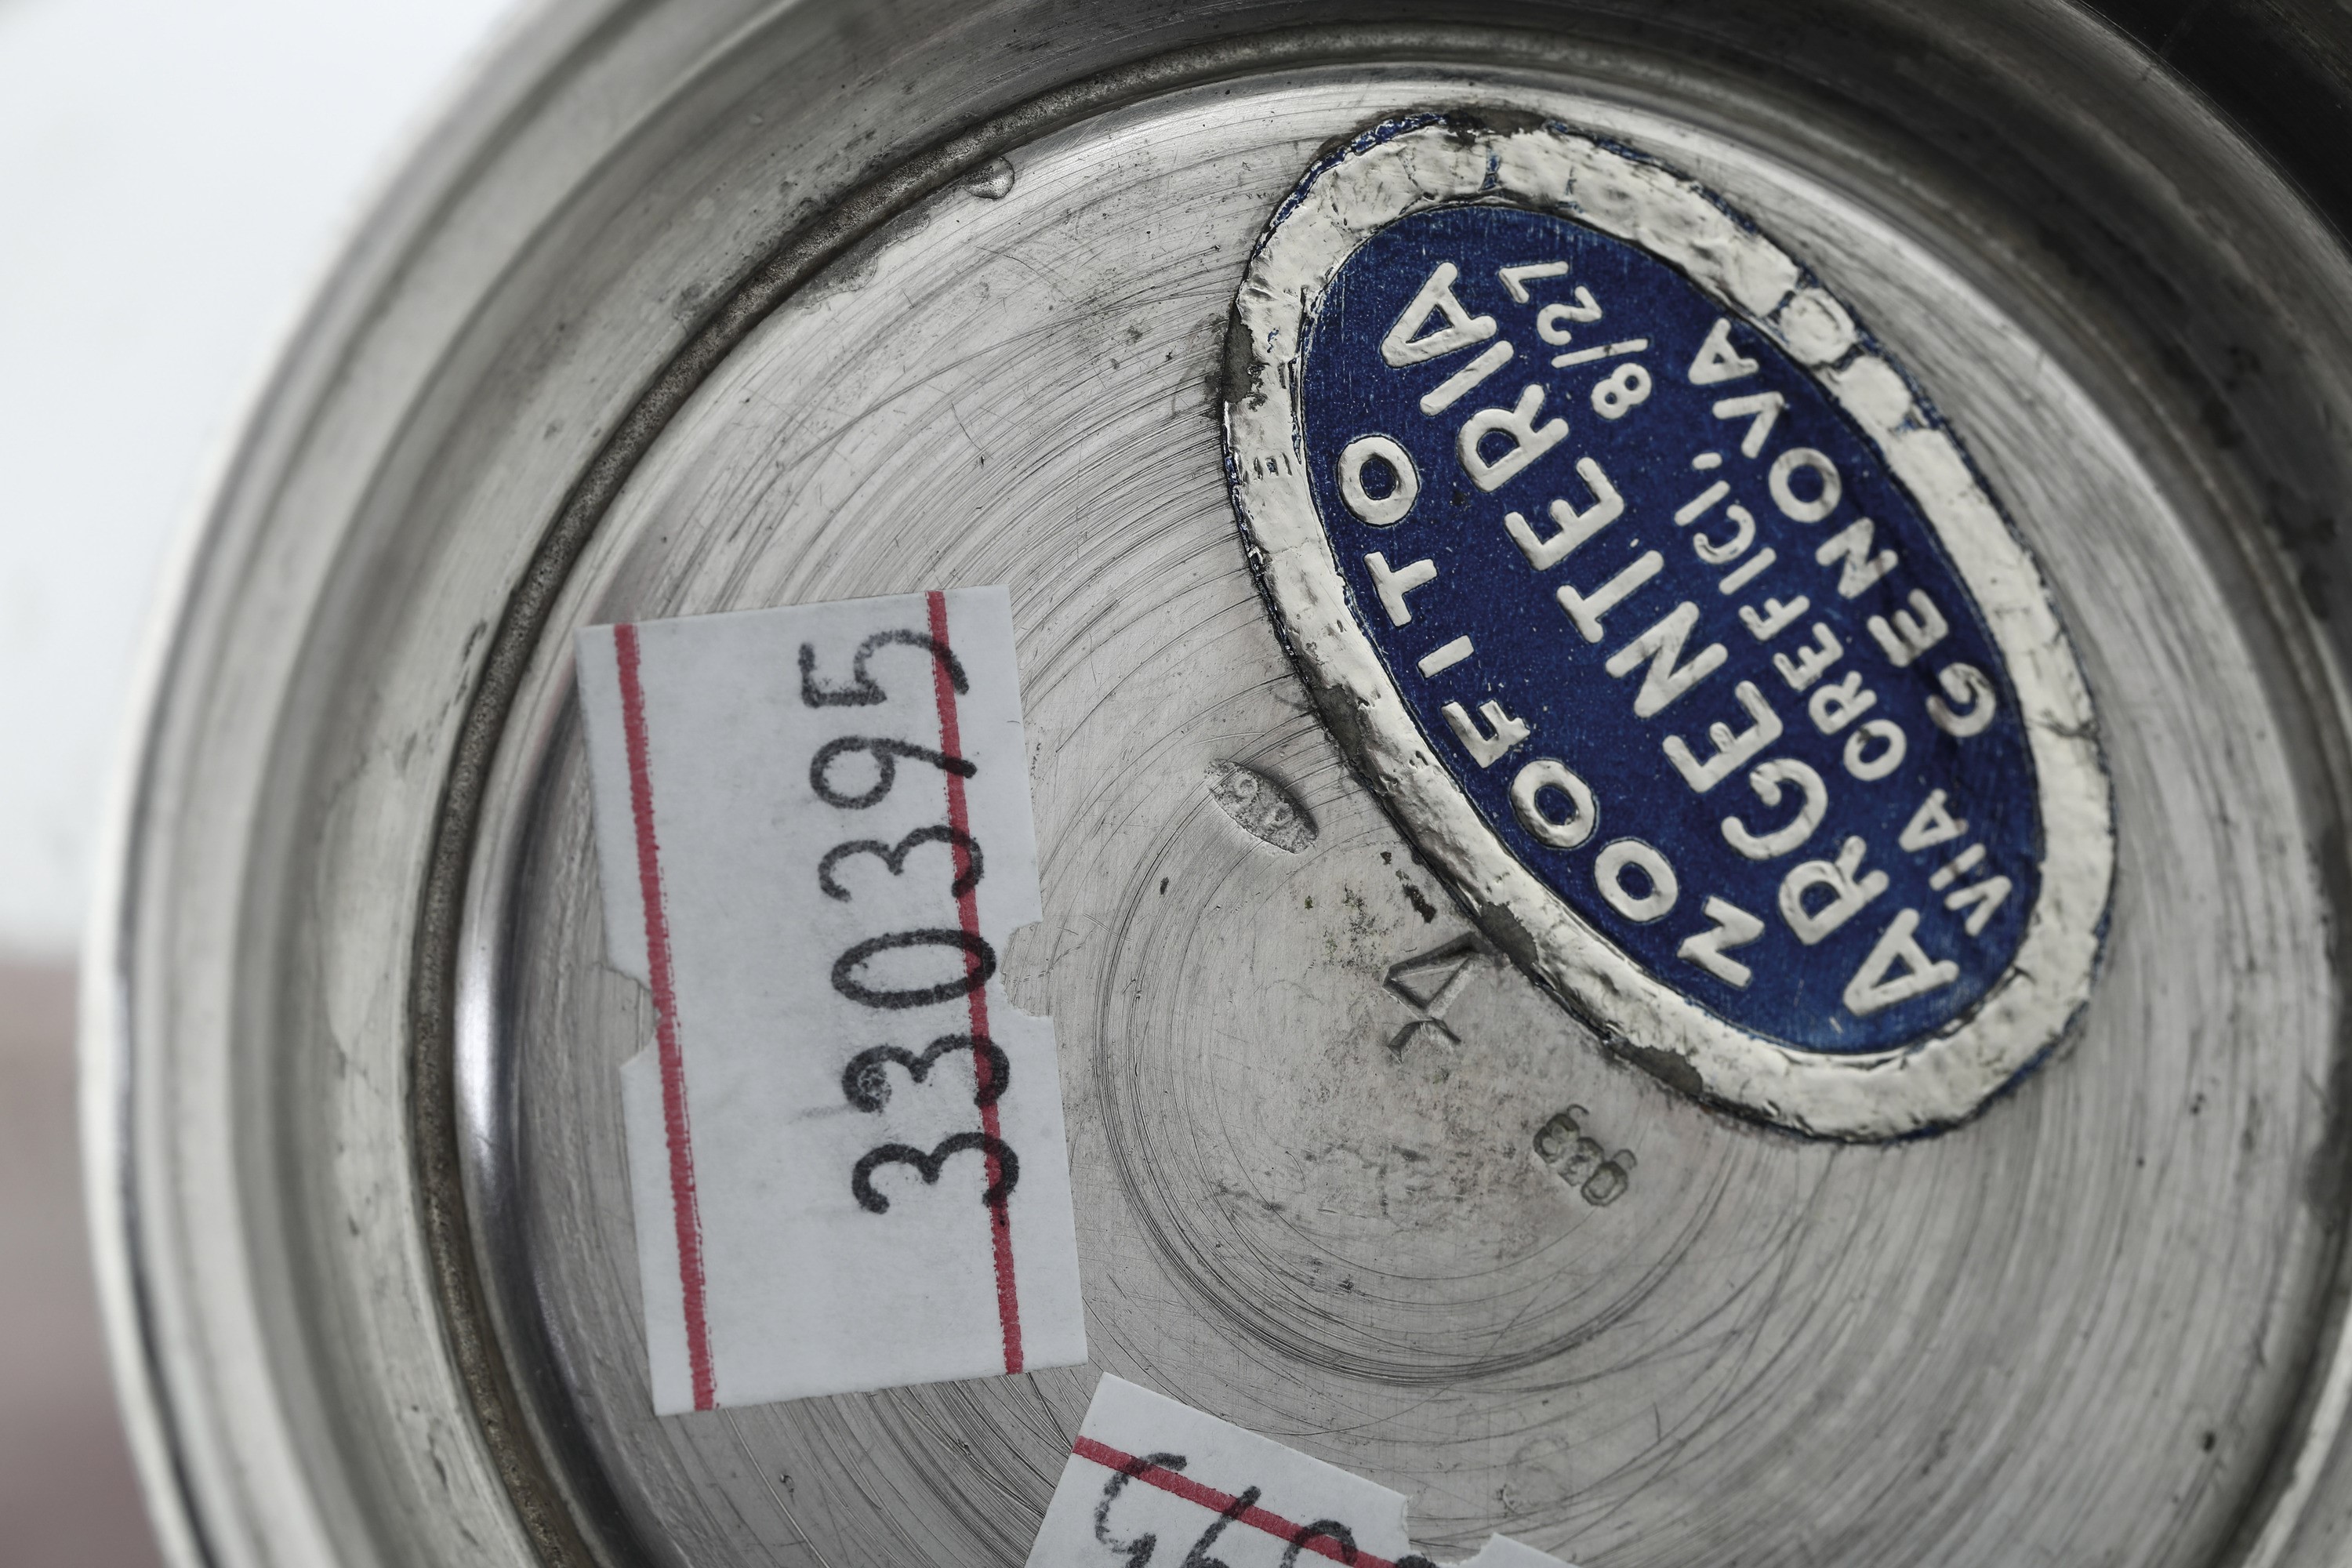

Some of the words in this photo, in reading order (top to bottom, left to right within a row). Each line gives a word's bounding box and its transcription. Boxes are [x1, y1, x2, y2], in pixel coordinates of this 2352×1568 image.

[1498, 260, 1653, 419] 8/27
[1687, 317, 1997, 739] GENOVA
[1336, 434, 1765, 989] ZOOFITO
[1380, 260, 1959, 1016] ARGENTERIA
[1674, 452, 1907, 782] OREFICI,
[798, 629, 1021, 1216] 330395
[1898, 788, 2013, 938] VIA
